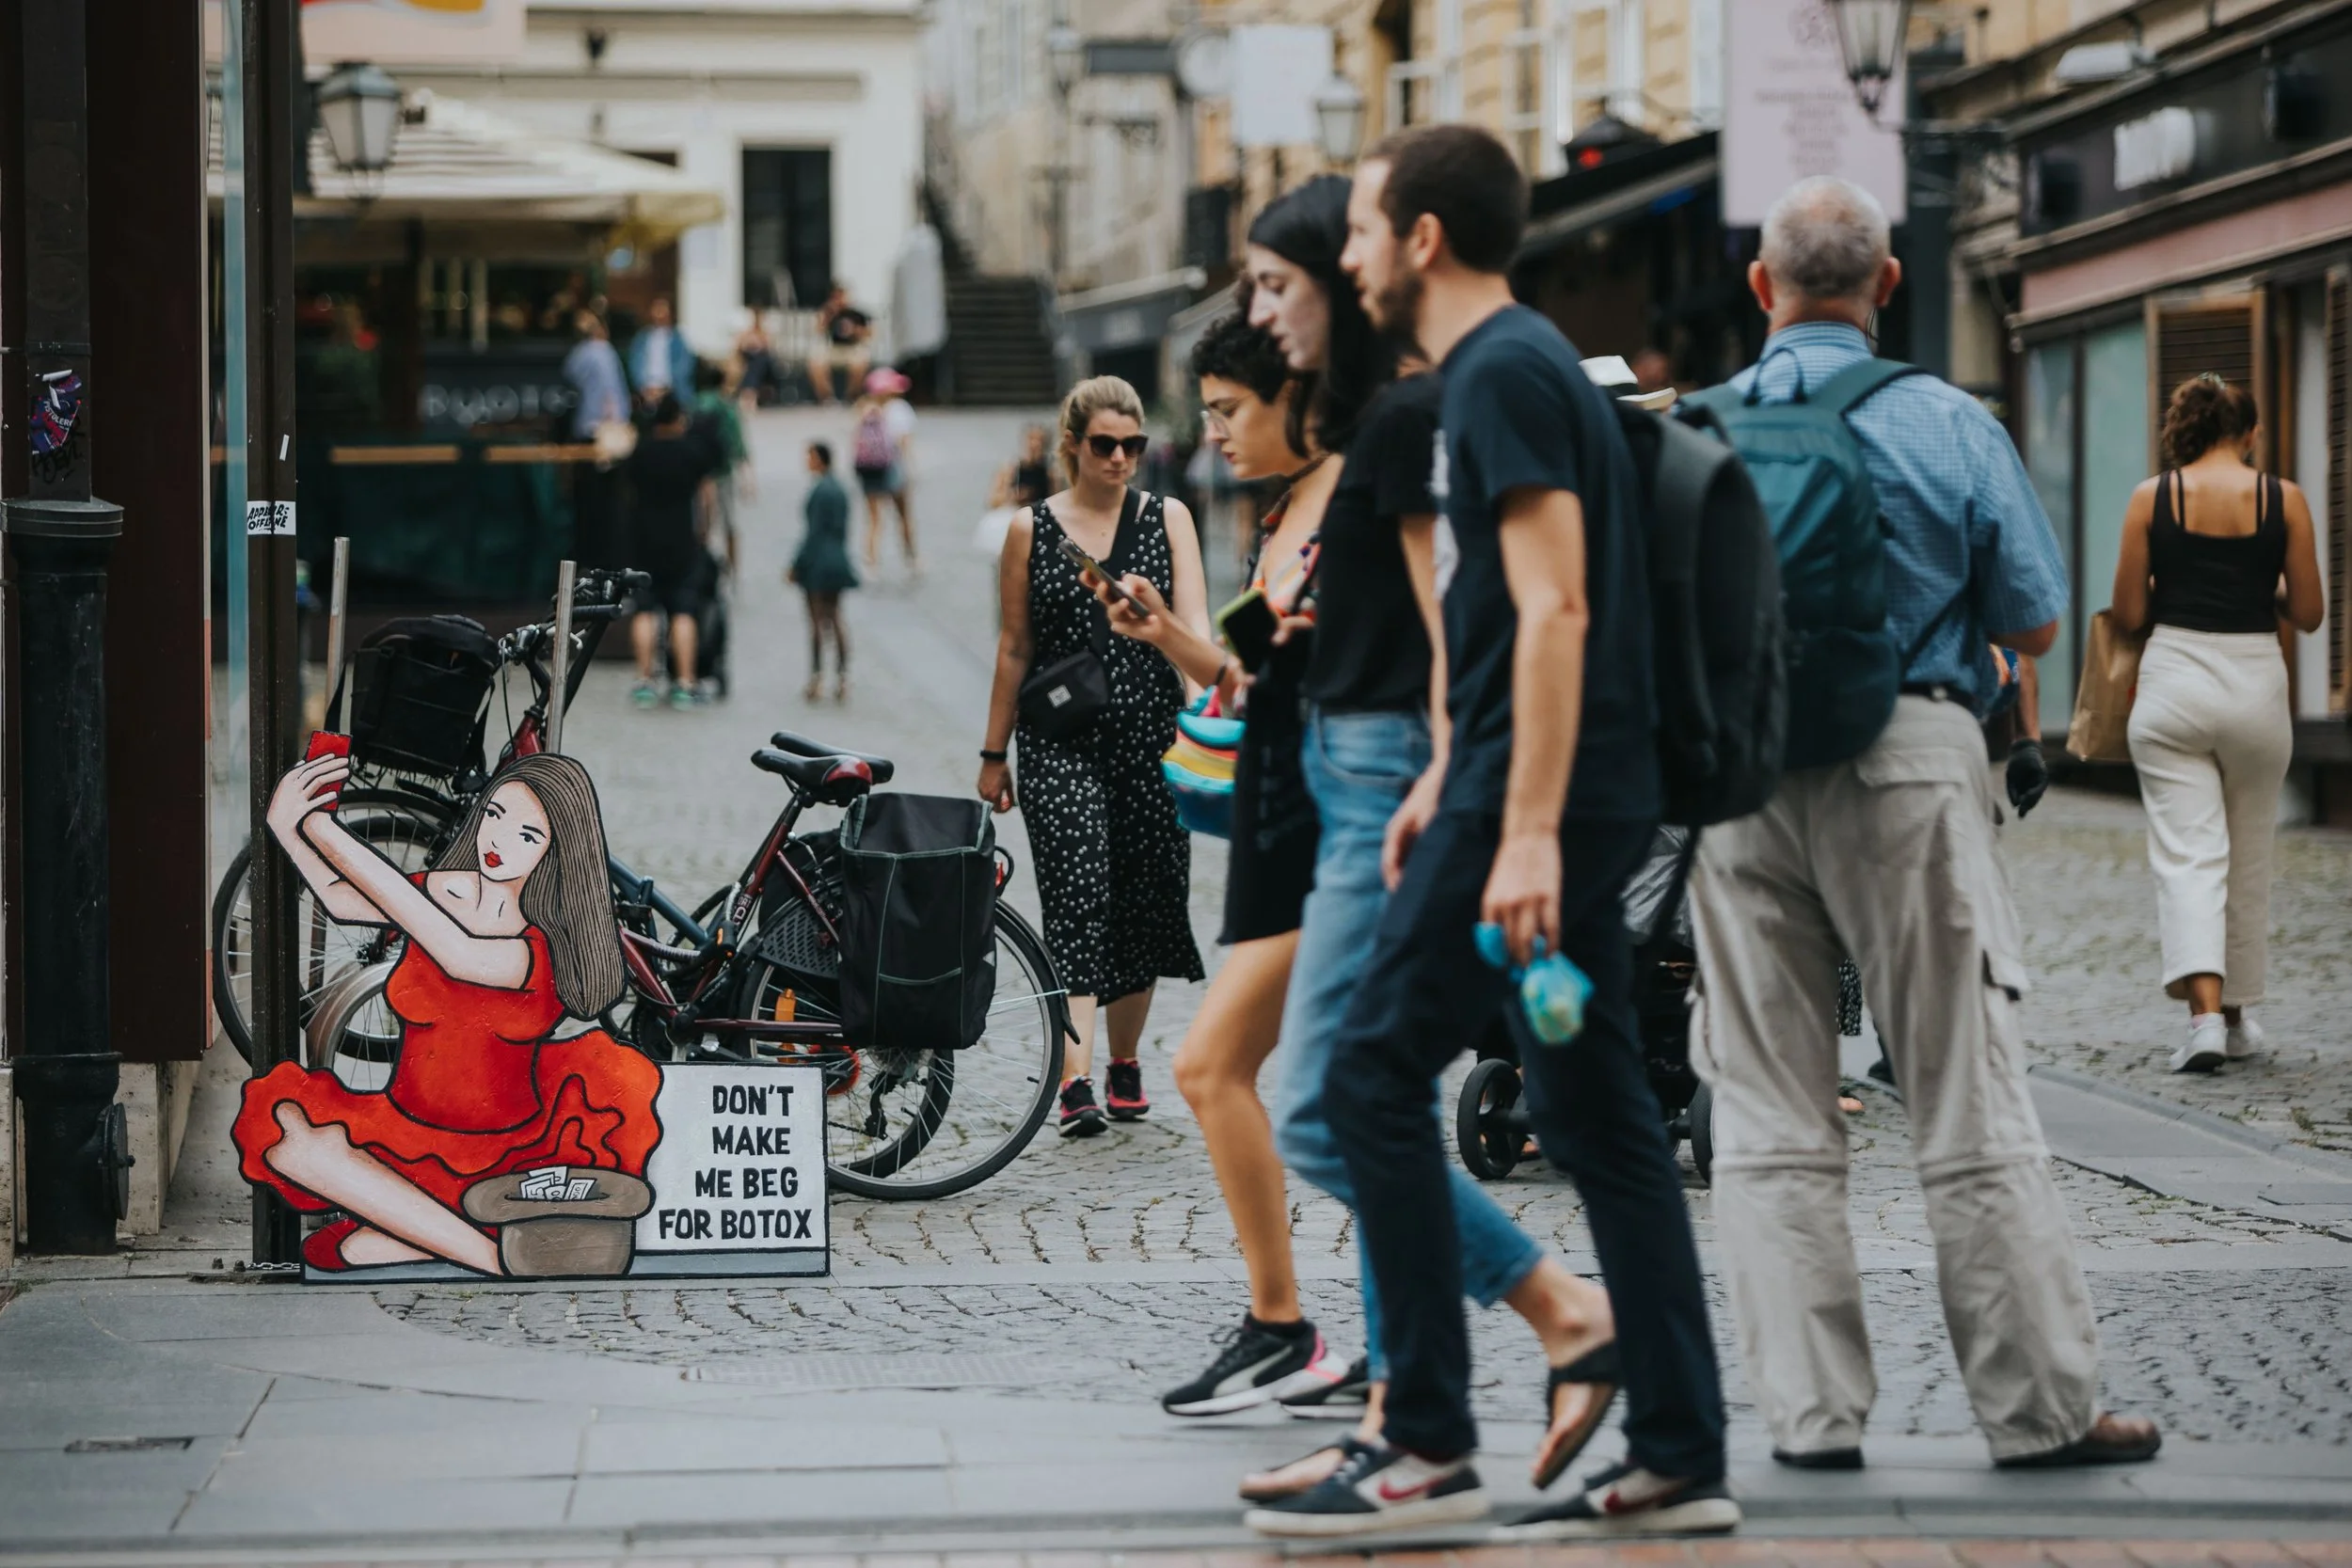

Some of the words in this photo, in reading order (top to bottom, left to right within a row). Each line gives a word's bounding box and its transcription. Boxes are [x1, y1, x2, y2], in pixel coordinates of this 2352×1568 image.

[712, 1084, 794, 1117] DON'T
[712, 1125, 790, 1155] MAKE
[695, 1167, 732, 1197] ME
[742, 1166, 798, 1199] BEG
[659, 1208, 713, 1240] FOR
[721, 1209, 812, 1240] BOTOX
